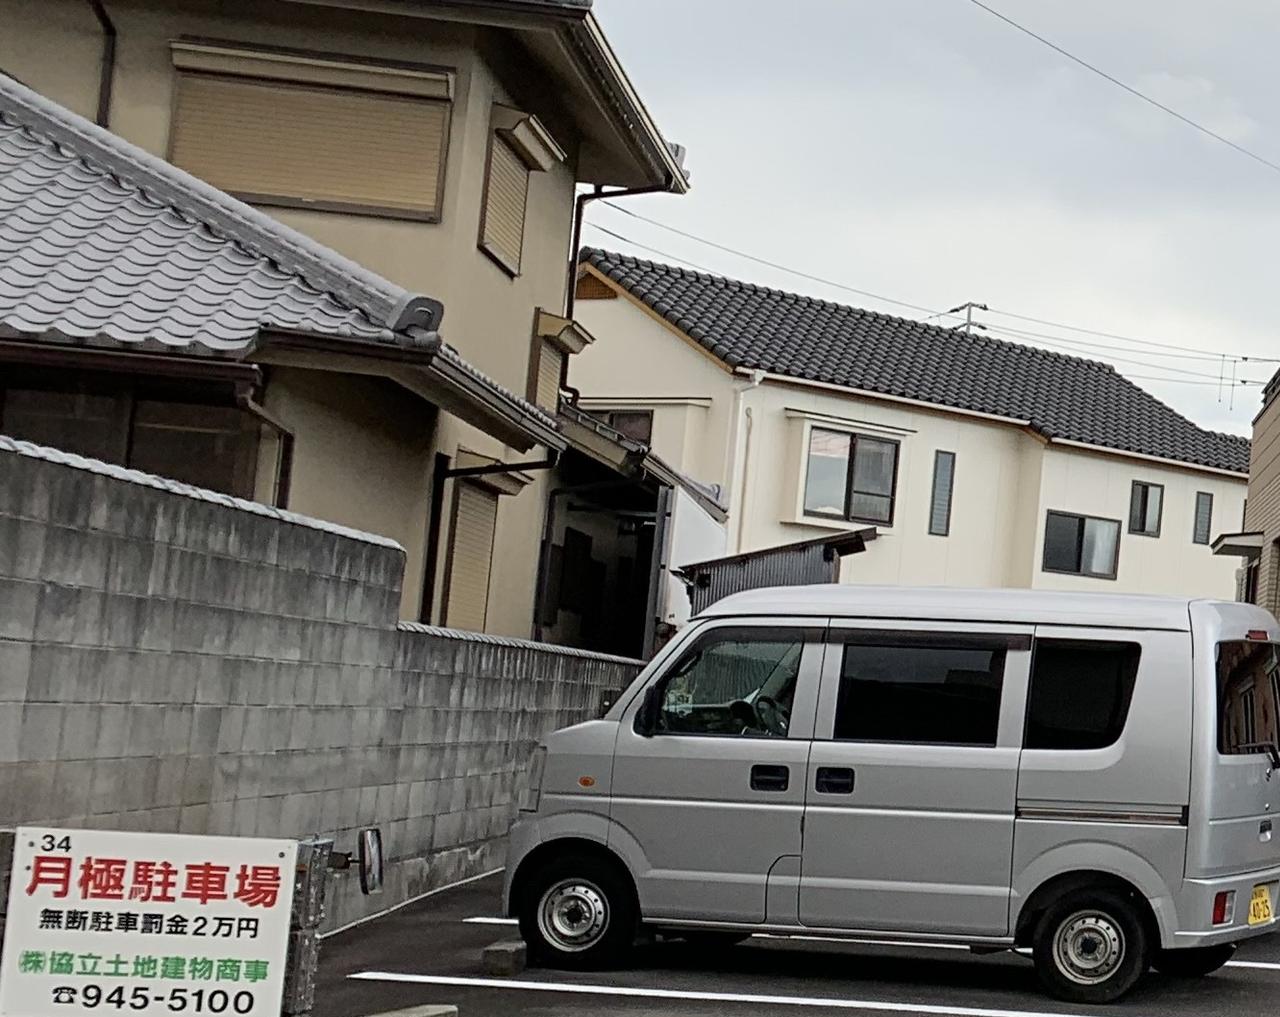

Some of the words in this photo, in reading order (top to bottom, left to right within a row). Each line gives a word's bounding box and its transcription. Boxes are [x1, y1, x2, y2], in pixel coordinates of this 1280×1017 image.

[40, 834, 72, 853] 34
[26, 856, 281, 908] 月極駐車場
[39, 908, 259, 938] 無断駐車罰金2万円
[81, 984, 255, 1014] 945-5100
